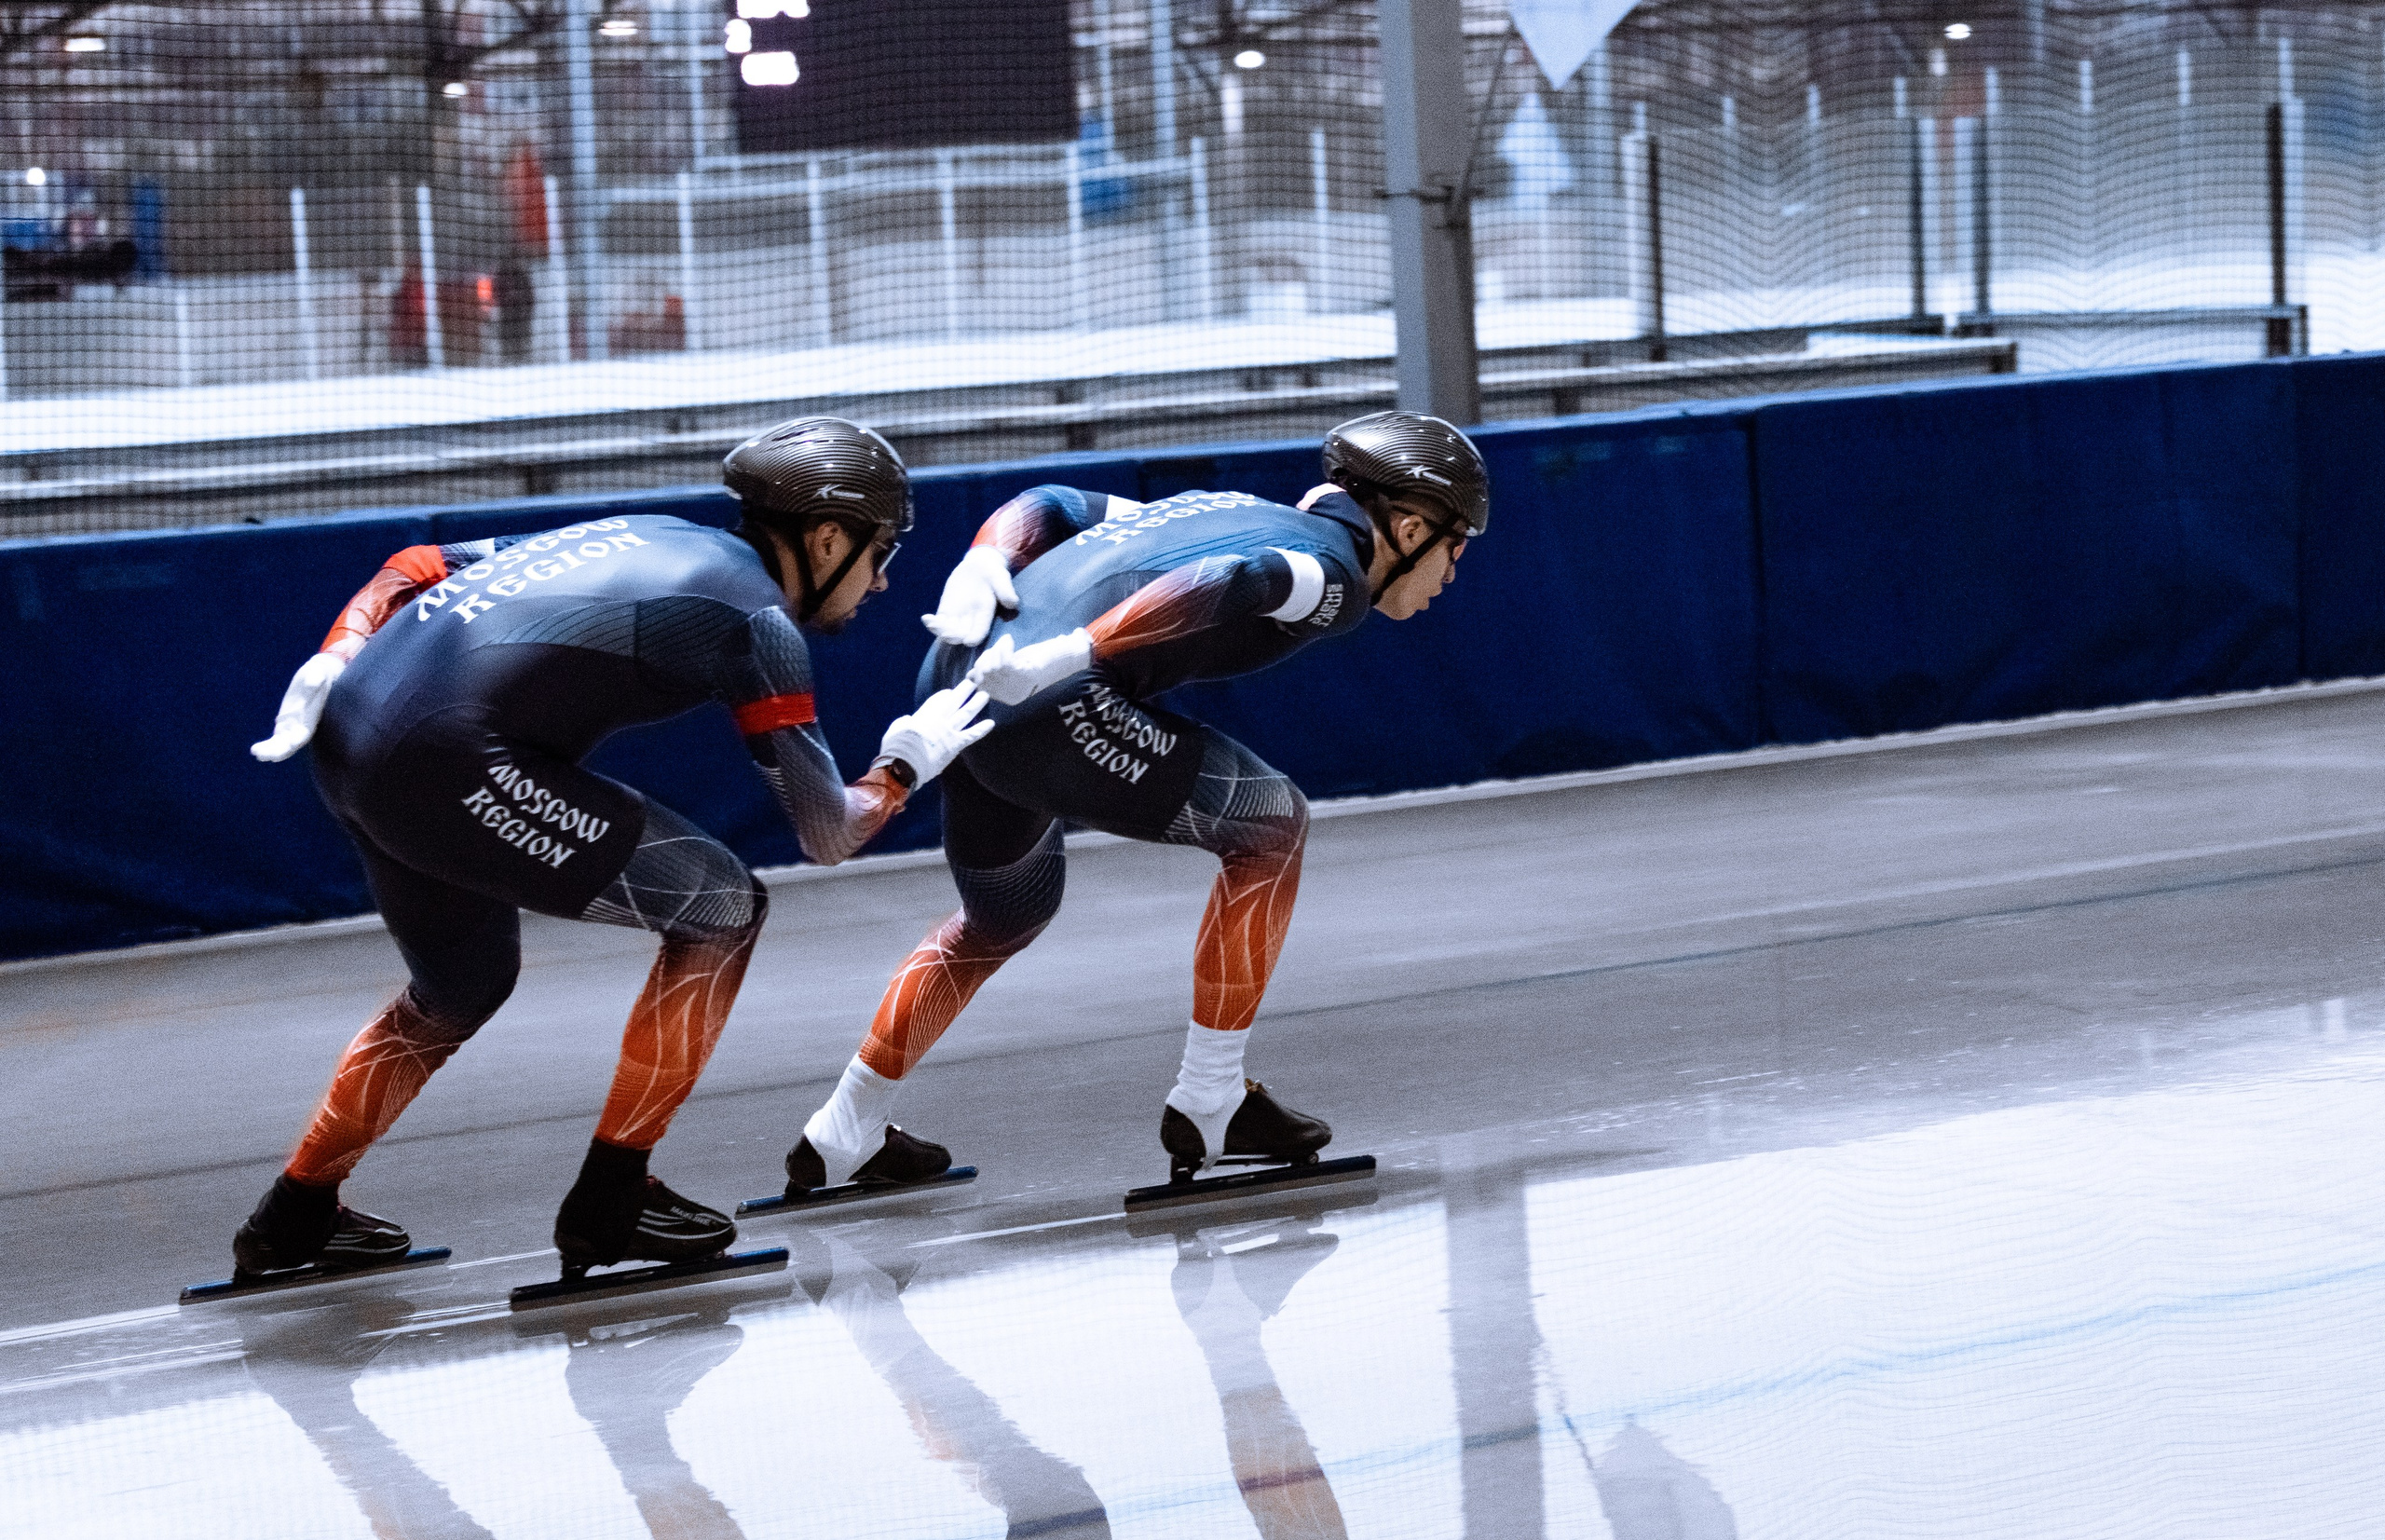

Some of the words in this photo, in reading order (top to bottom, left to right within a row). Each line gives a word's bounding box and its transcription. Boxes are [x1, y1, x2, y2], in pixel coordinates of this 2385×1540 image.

[416, 518, 629, 621] MOSCOW
[449, 532, 650, 624] REGION
[1058, 700, 1150, 785] REGION
[461, 785, 578, 869] REGION
[487, 762, 610, 843] MOSCOW
